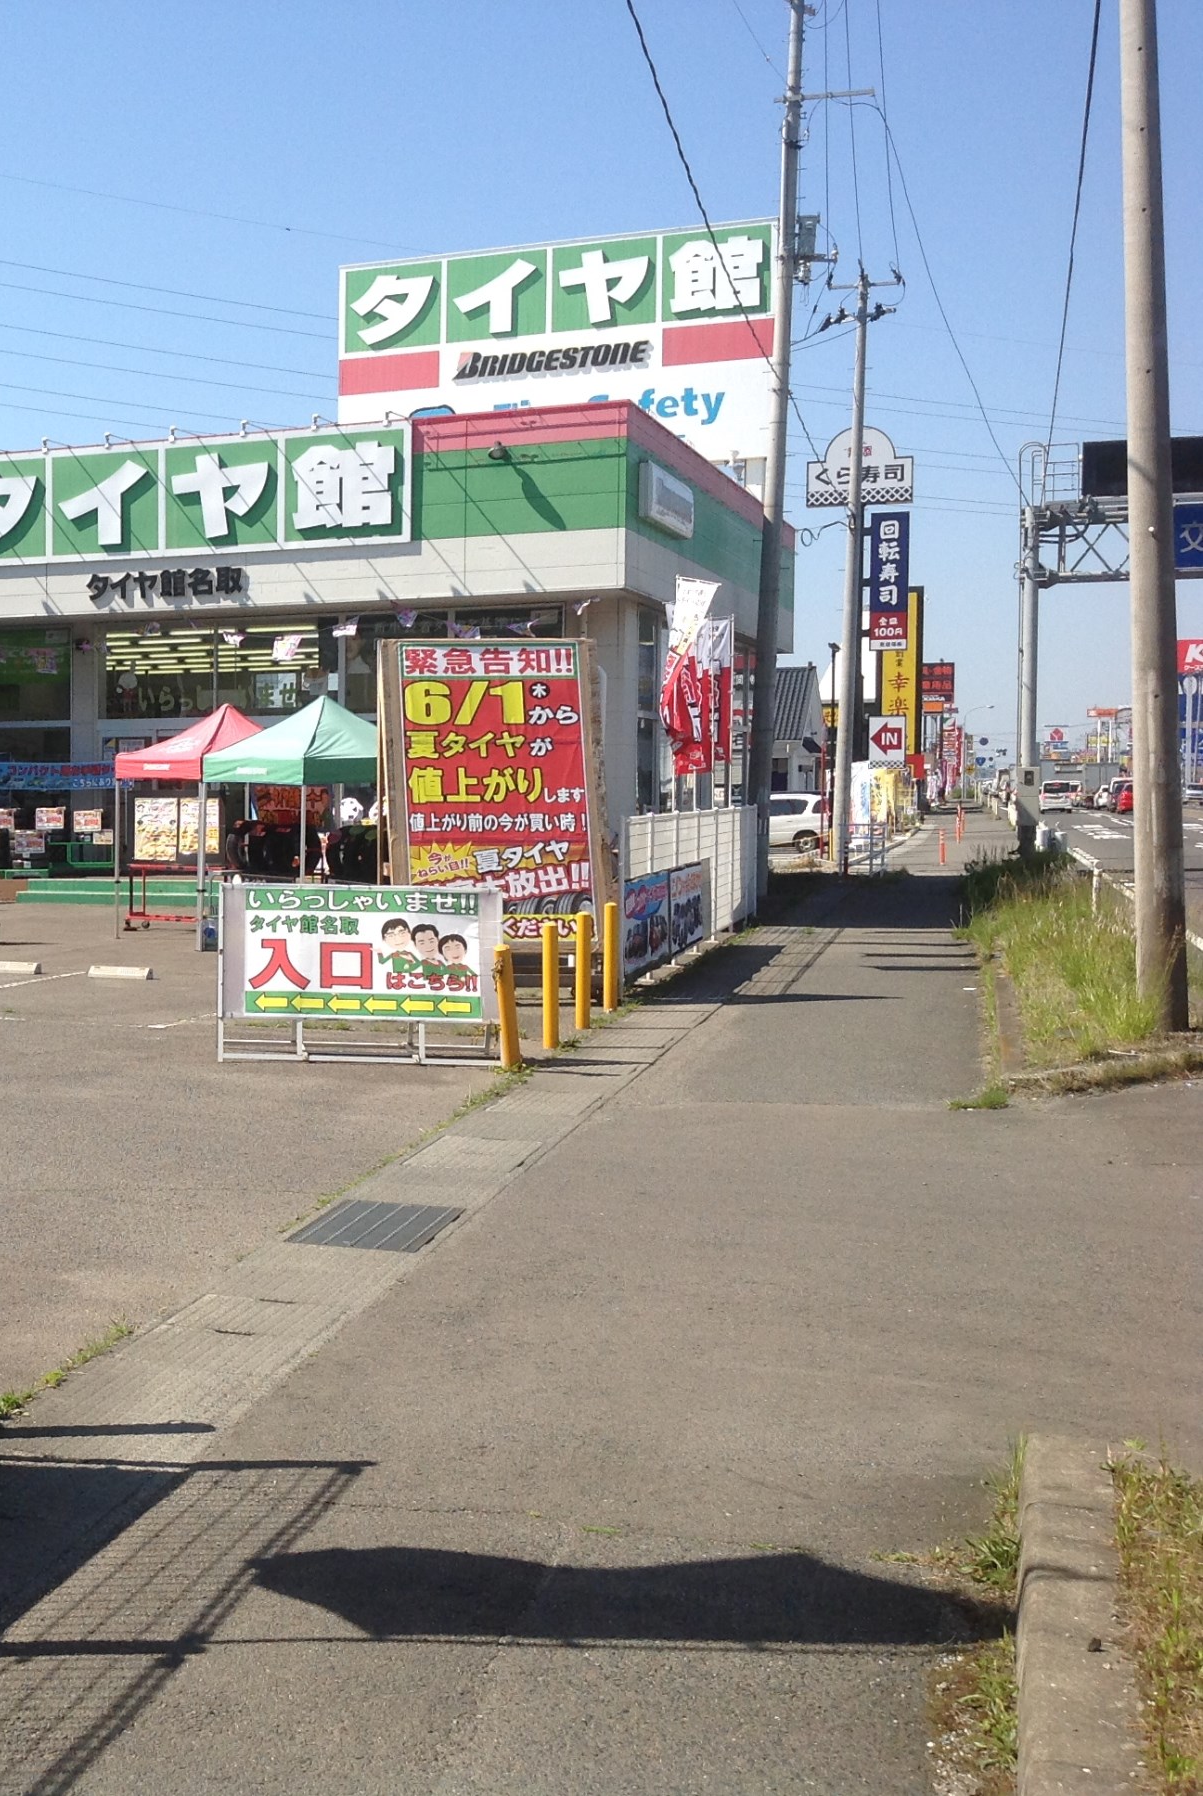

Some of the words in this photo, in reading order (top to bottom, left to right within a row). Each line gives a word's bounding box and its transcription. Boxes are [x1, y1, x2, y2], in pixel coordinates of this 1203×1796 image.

[349, 235, 764, 345] タイヤ館
[453, 339, 649, 381] BRIDGESTONE
[815, 463, 905, 485] くら寿司
[878, 520, 901, 606] 回転寿司
[86, 566, 244, 601] タイヤ館名取
[873, 627, 903, 637] 100円
[404, 647, 574, 675] 緊急告知!!
[407, 731, 554, 759] 夏タイヤが
[881, 732, 898, 746] IN
[408, 767, 585, 804] 値上がりします
[417, 859, 469, 878] ねらい目!!
[473, 840, 570, 874] 夏タイヤ
[418, 862, 590, 899] 大放出!!
[248, 889, 476, 915] いらっしゃいませ!!
[250, 915, 360, 935] タイヤ館名取
[248, 938, 374, 990] 入口
[386, 972, 478, 992] はこちら!!
